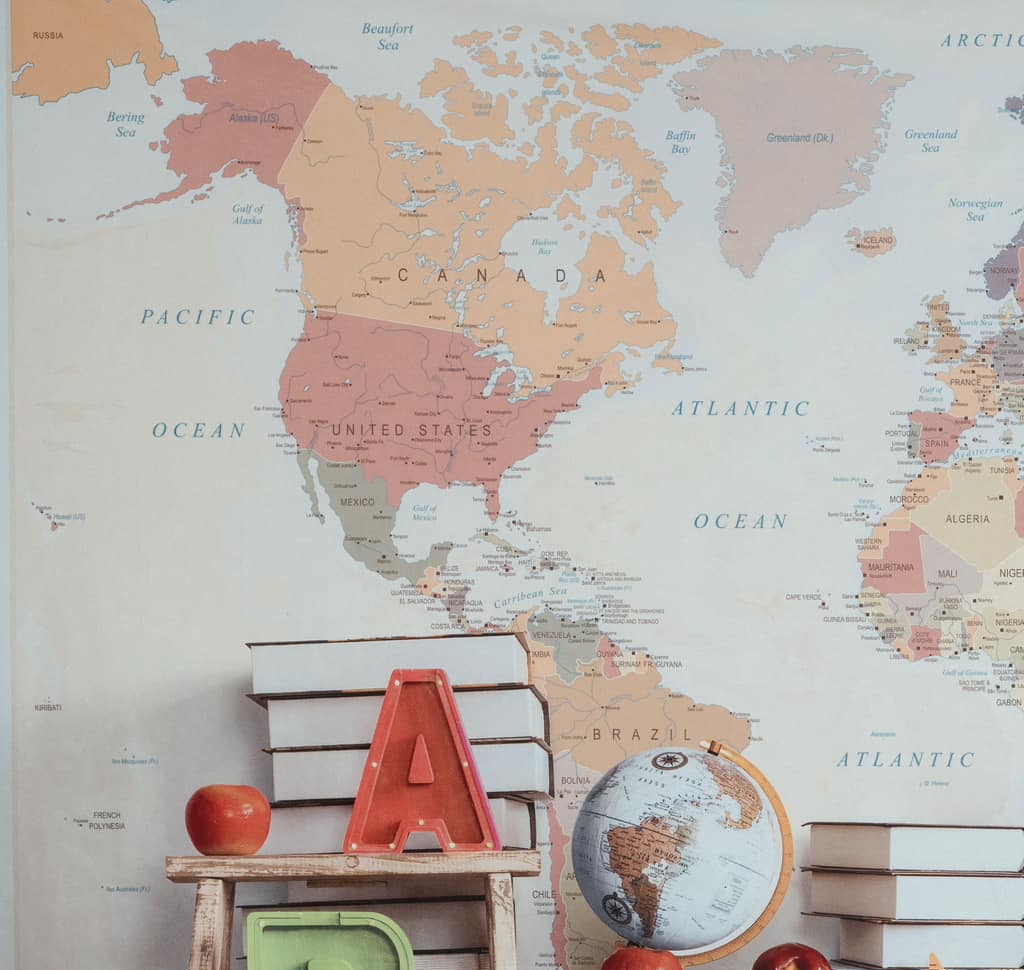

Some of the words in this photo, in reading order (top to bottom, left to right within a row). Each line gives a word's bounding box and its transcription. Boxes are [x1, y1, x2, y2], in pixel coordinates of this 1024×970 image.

[33, 31, 63, 39] RUSSIA
[361, 23, 413, 36] Beaufort
[378, 39, 399, 51] Sea
[106, 111, 145, 125] Bering
[229, 113, 256, 123] Alaska
[259, 113, 279, 124] (US)
[116, 126, 136, 137] Sea
[666, 130, 696, 141] Baffin
[904, 128, 957, 141] Greenland
[767, 133, 810, 143] Greenland
[672, 143, 690, 155] Bay
[921, 142, 940, 153] Sea
[232, 204, 251, 216] Gulf
[254, 204, 264, 216] of
[948, 198, 1003, 211] Norwegian
[232, 214, 263, 226] Alaska
[966, 211, 985, 222] Sea
[398, 268, 605, 283] CANADA
[141, 309, 256, 325] PACIFIC
[671, 400, 810, 417] ATLANTIC
[152, 422, 246, 438] OCEAN
[332, 424, 404, 436] UNITED
[418, 424, 492, 437] STATES
[340, 498, 375, 507] MEXICO
[694, 513, 789, 529] OCEAN
[946, 514, 990, 523] ALGERIA
[868, 563, 914, 572] MAURITANIA
[938, 570, 958, 578] MALI
[549, 586, 568, 596] Sea
[995, 619, 1024, 627] NIGERIA
[593, 729, 692, 741] BRAZIL
[343, 668, 501, 853] A
[836, 752, 976, 768] ATLANTIC
[532, 890, 556, 899] CHILE
